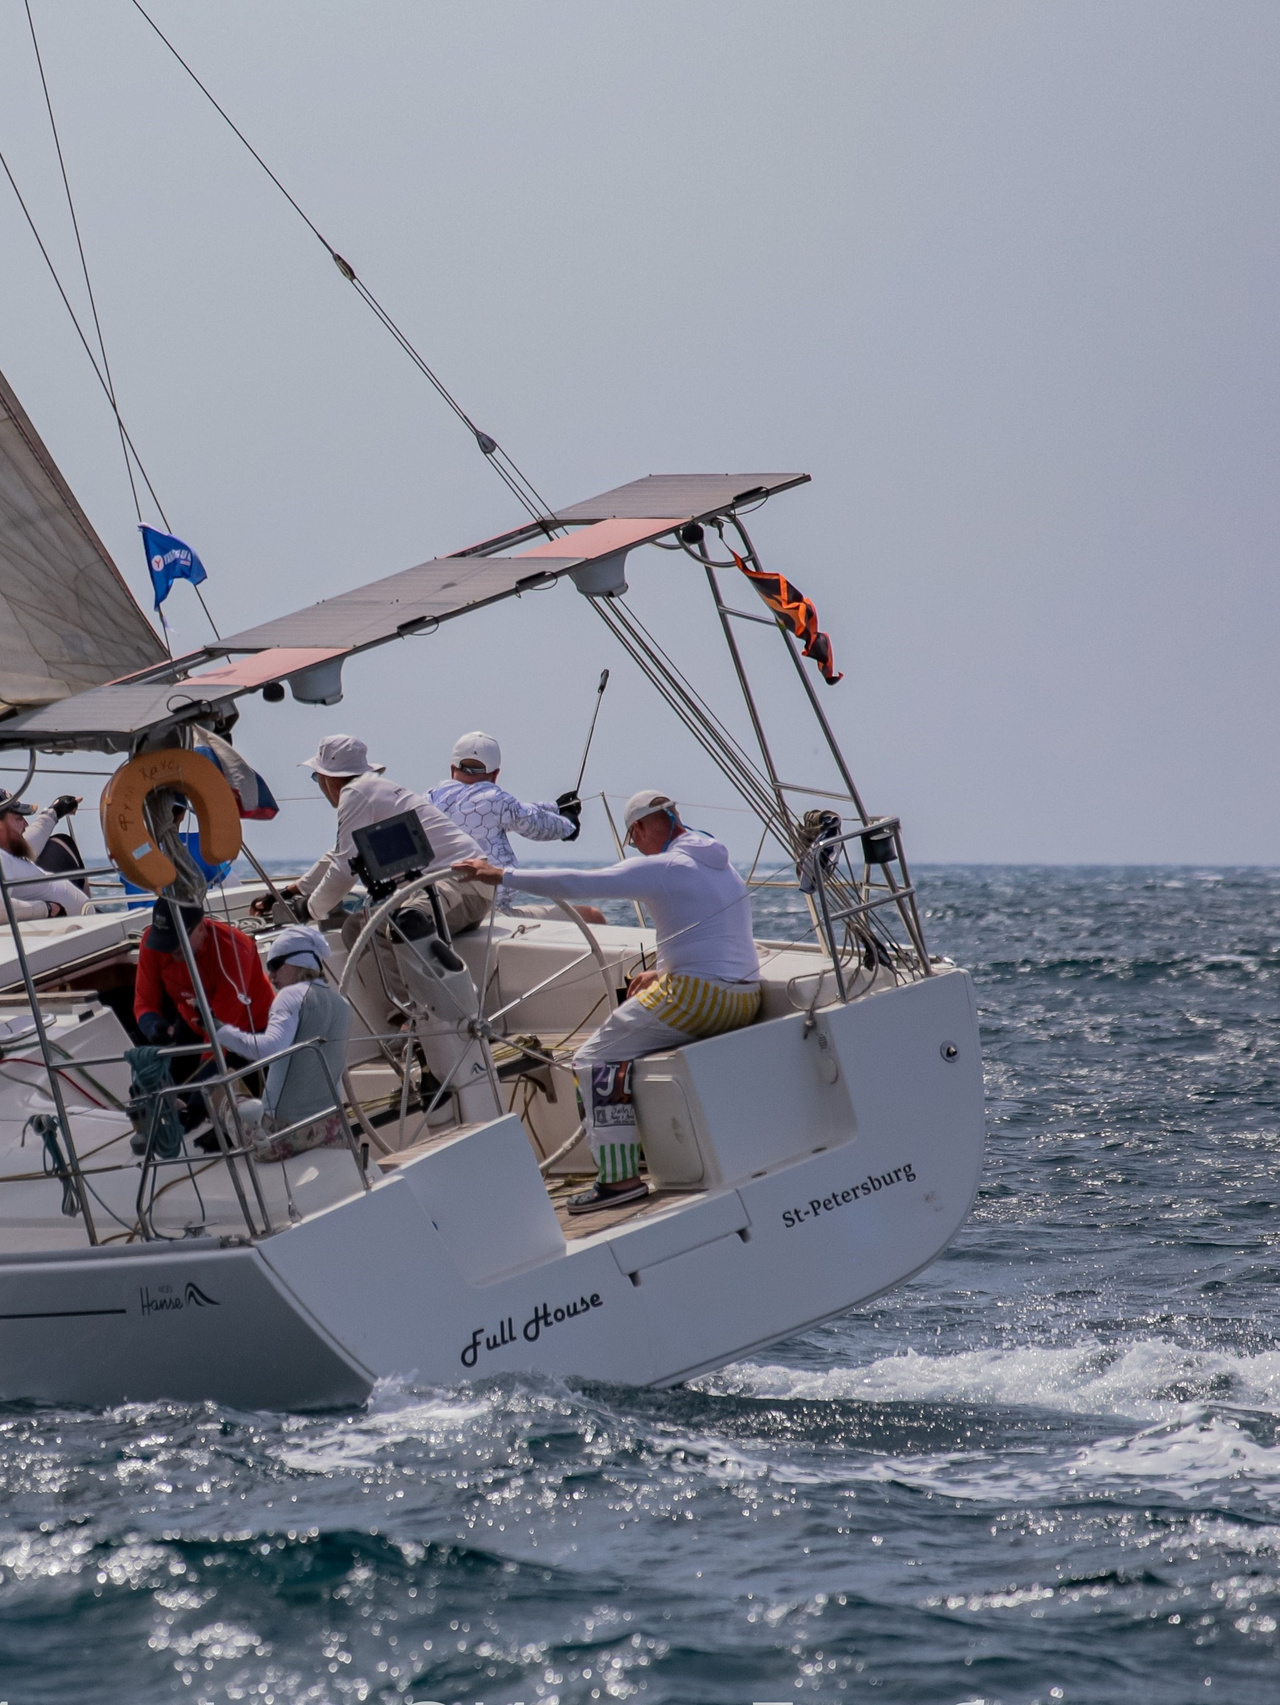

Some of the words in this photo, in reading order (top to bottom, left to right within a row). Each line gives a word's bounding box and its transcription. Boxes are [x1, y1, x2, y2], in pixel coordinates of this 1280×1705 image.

[782, 1163, 917, 1228] St-Petersburg
[140, 1286, 183, 1316] Hanse
[461, 1317, 517, 1368] Full
[523, 1293, 603, 1342] House
